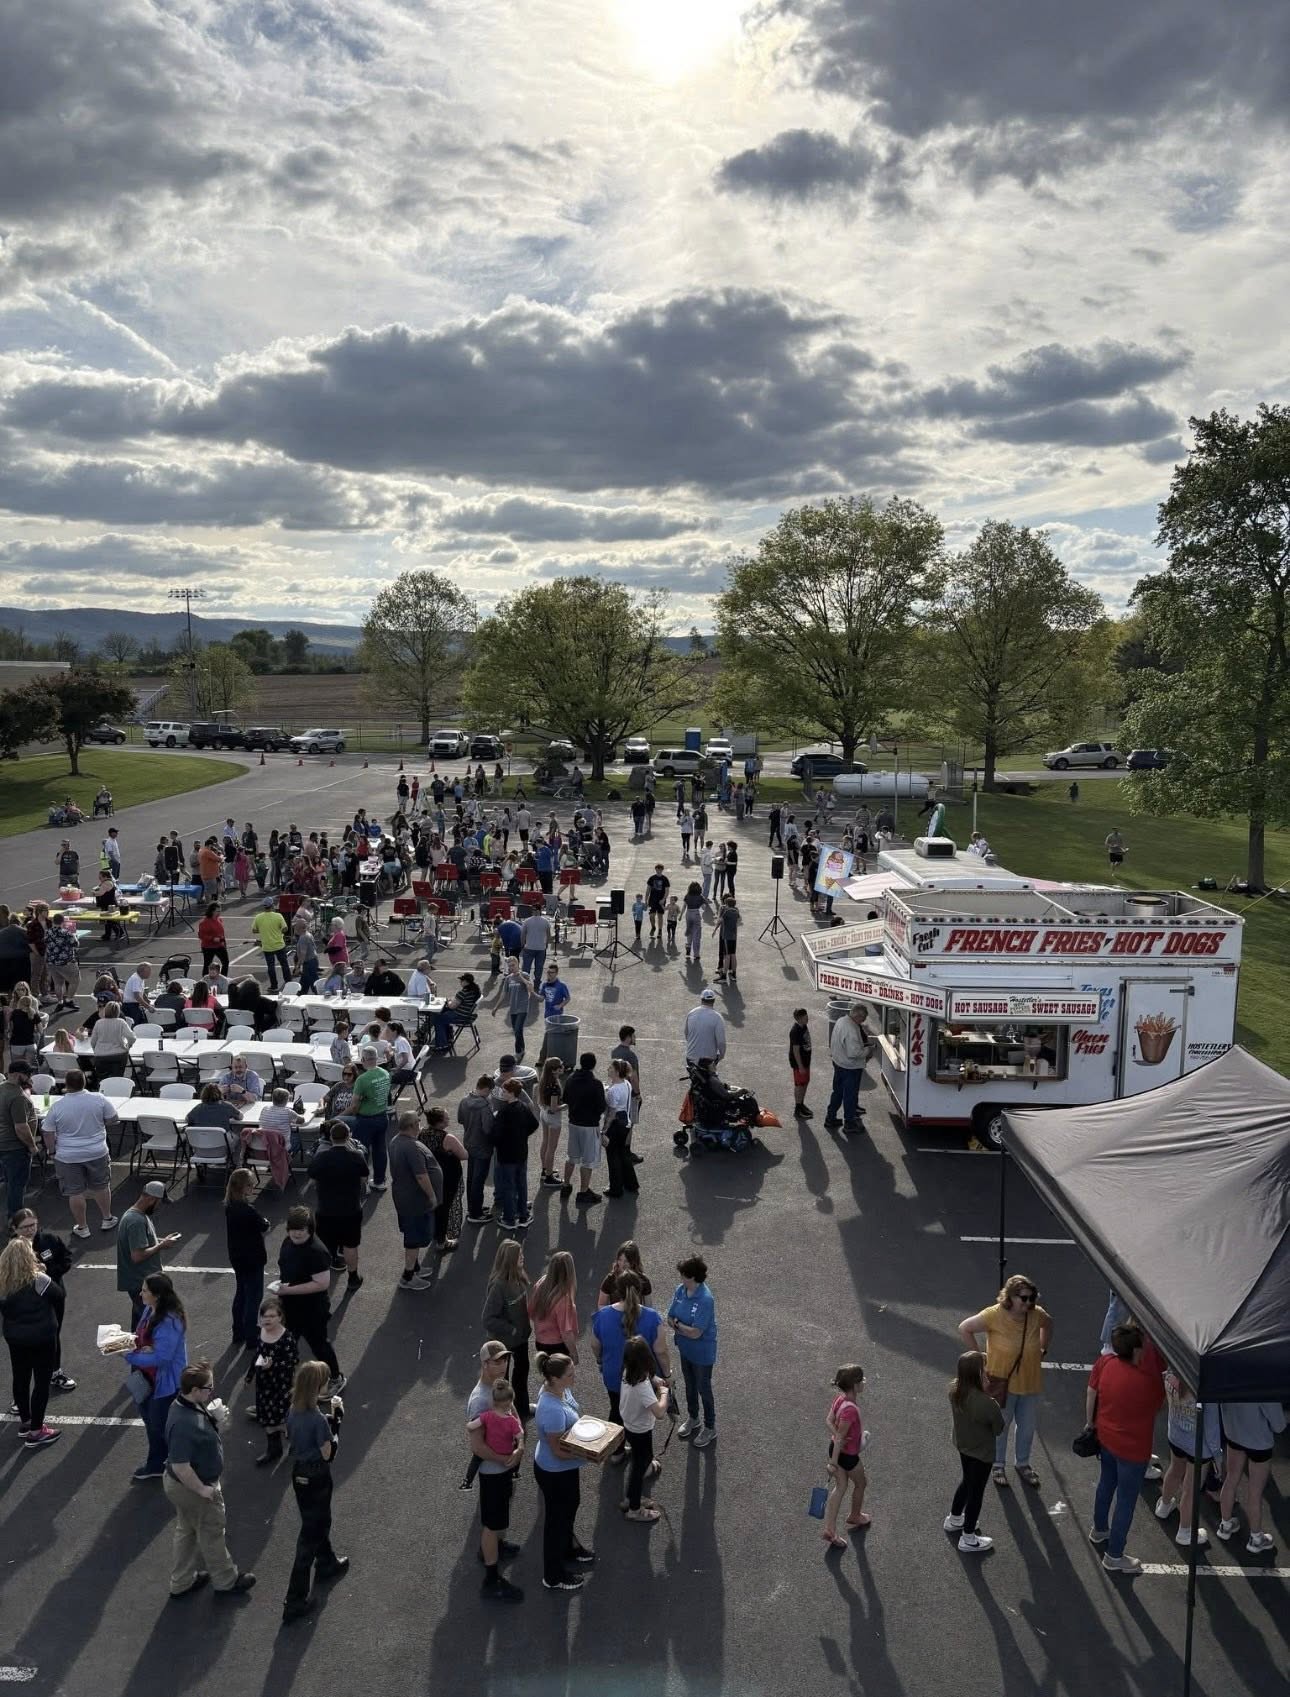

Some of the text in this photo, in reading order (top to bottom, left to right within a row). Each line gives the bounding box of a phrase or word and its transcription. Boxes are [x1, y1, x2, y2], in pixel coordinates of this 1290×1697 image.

[943, 929, 1226, 956] FRENCH FRIES HOT DOGS
[820, 973, 943, 1010] FRESH CUT FRIES DRINKS HOT DOGS
[955, 1002, 971, 1013] HOT
[973, 1002, 1008, 1013] SAUSAGE
[1032, 1003, 1058, 1014] SWEET
[1061, 1003, 1096, 1014] SAUSAGE
[911, 1013, 925, 1065] INKS
